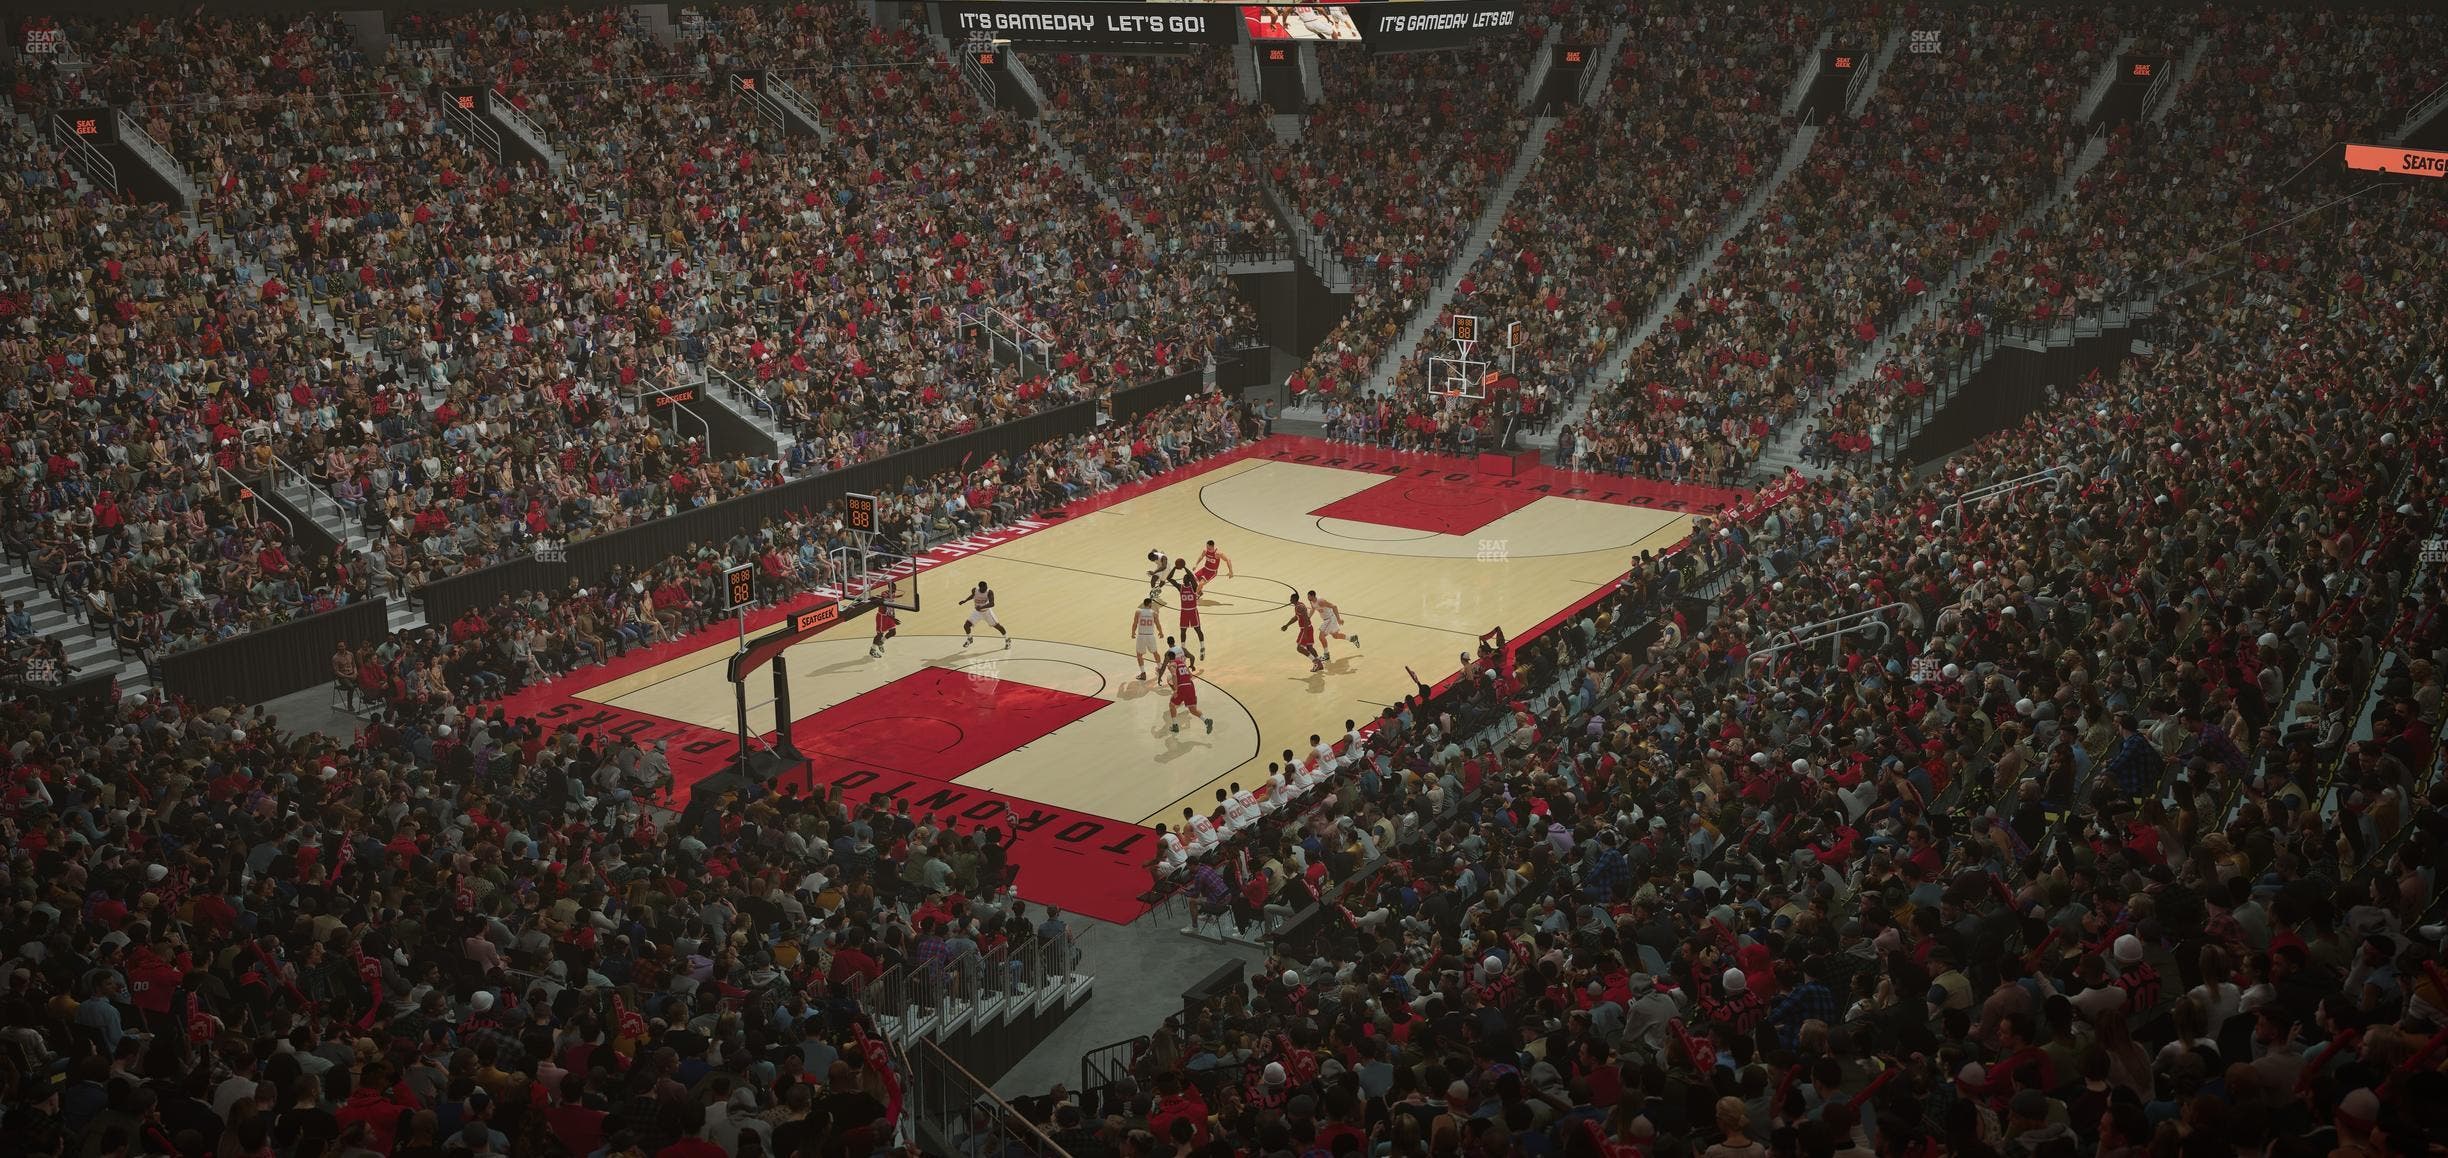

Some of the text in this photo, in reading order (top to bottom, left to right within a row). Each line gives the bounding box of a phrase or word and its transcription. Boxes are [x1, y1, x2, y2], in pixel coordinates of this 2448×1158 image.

[960, 13, 1206, 33] IT'S GAMEDAY LET'S GO!
[1380, 10, 1515, 32] IT'S GAMEDAY LET'S GO!
[77, 126, 98, 134] GEEK
[1270, 451, 1469, 481] TORONTO
[852, 510, 869, 528] 88
[734, 583, 749, 603] 88
[801, 607, 835, 629] SEATGEEK
[831, 770, 1147, 856] TORONTO
[134, 981, 149, 991] 00
